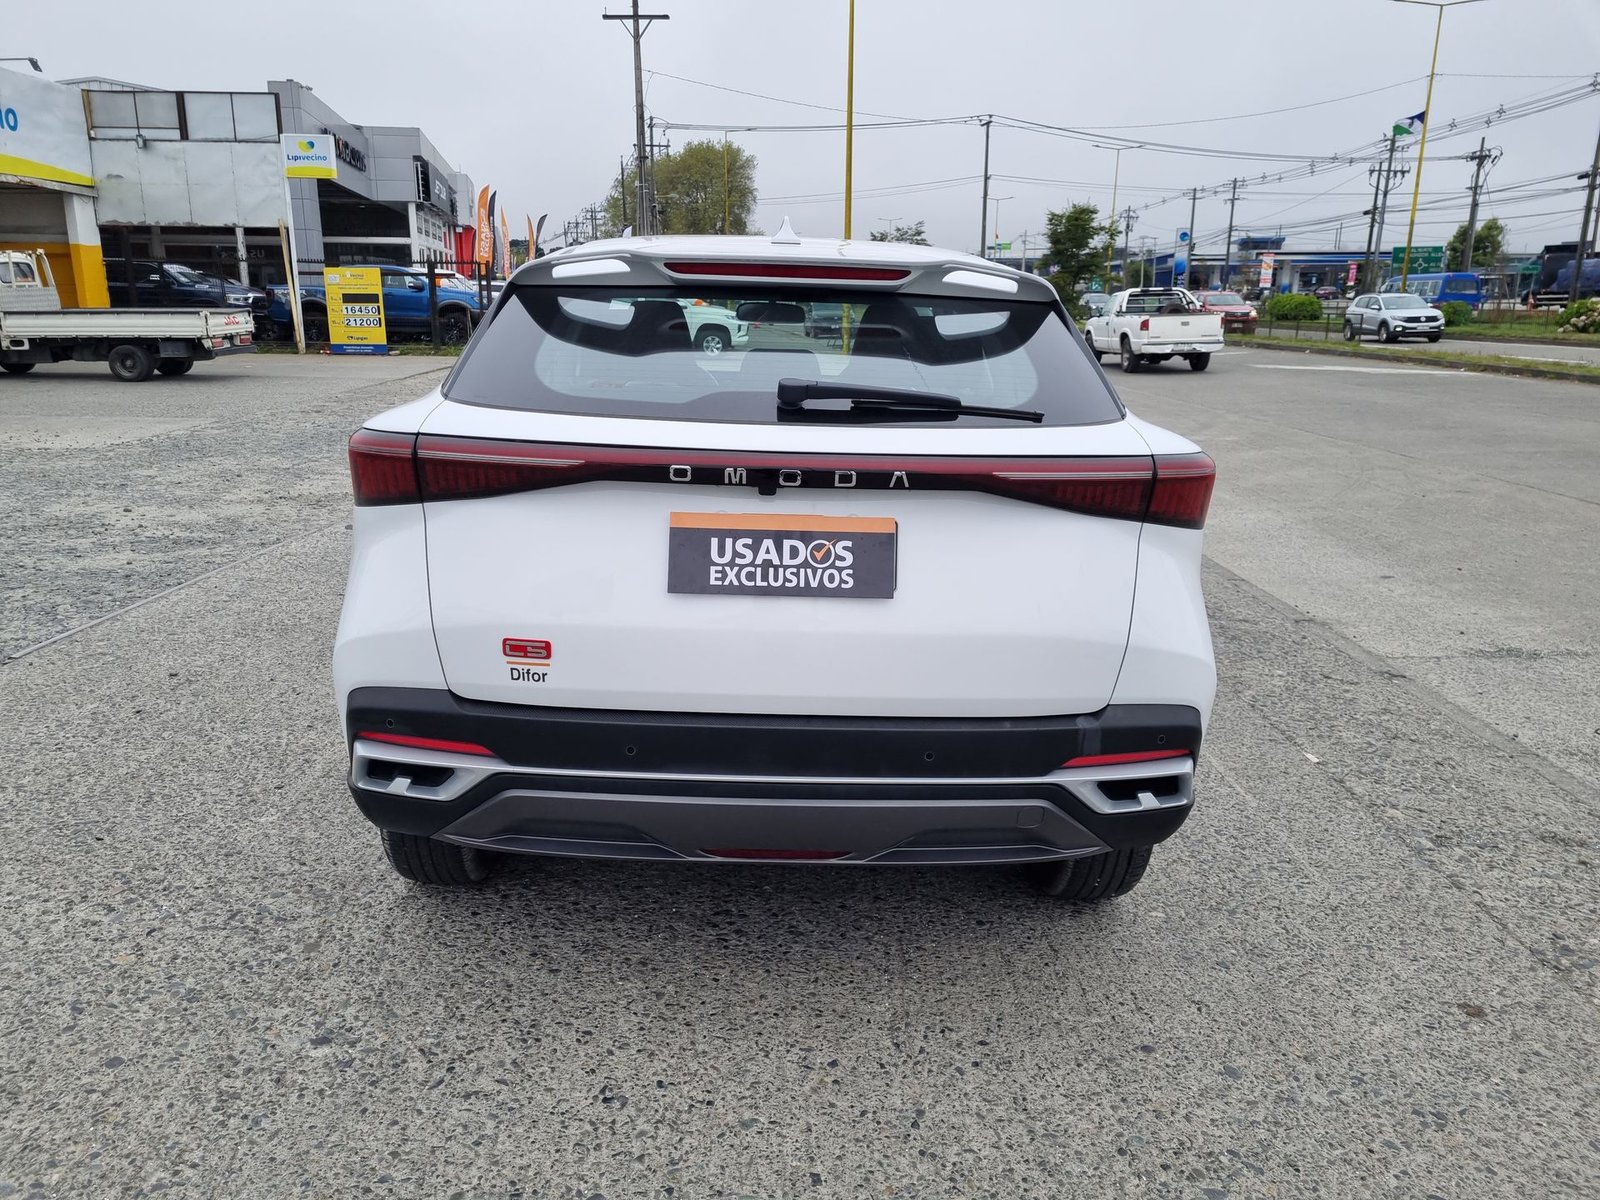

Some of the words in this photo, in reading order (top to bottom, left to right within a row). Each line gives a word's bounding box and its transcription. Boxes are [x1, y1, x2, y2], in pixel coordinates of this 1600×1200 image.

[287, 153, 328, 162] Lipivecino
[344, 306, 377, 314] 16450
[224, 315, 240, 326] JAC
[345, 318, 379, 326] 21200
[669, 464, 910, 488] OMODA
[710, 537, 854, 568] USADOS
[709, 565, 854, 589] EXCLUSIVOS
[510, 667, 548, 683] Difor
